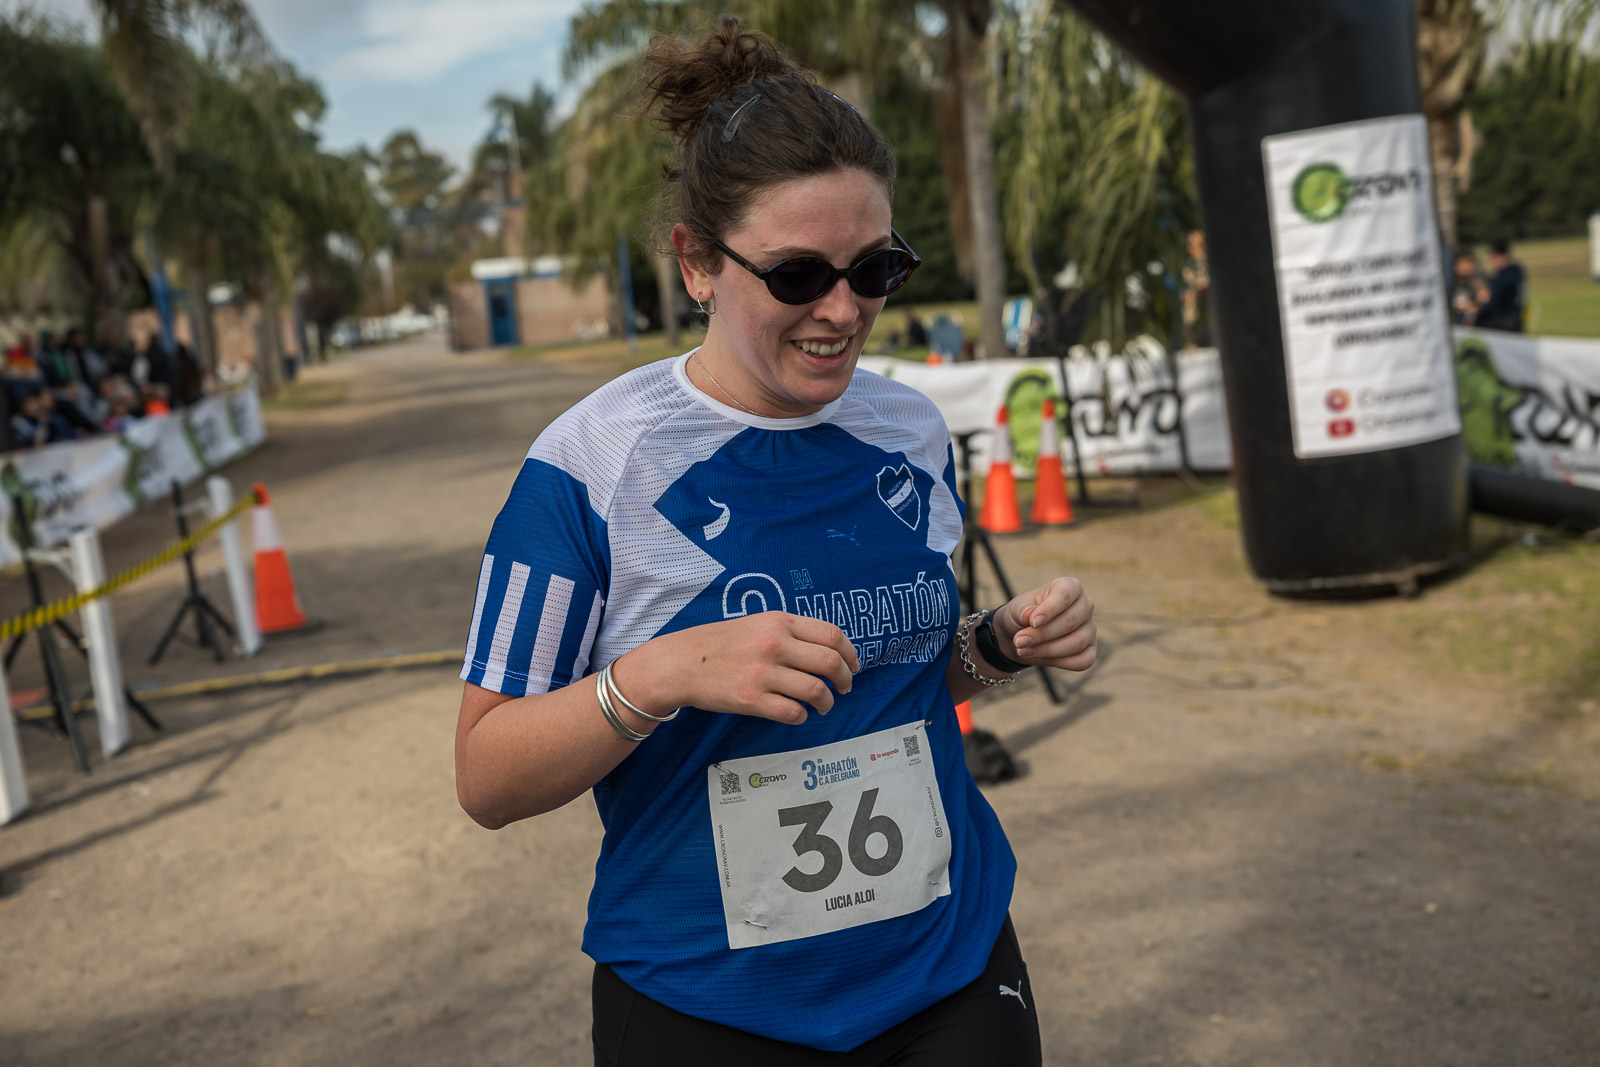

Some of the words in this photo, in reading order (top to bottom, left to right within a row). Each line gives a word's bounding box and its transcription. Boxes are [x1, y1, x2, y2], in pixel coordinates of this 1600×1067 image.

[790, 568, 815, 591] RA
[801, 760, 817, 790] 3
[818, 756, 857, 776] MARATÓN
[778, 788, 903, 892] 36
[825, 894, 853, 911] LUCIA
[855, 888, 875, 905] ALOI
